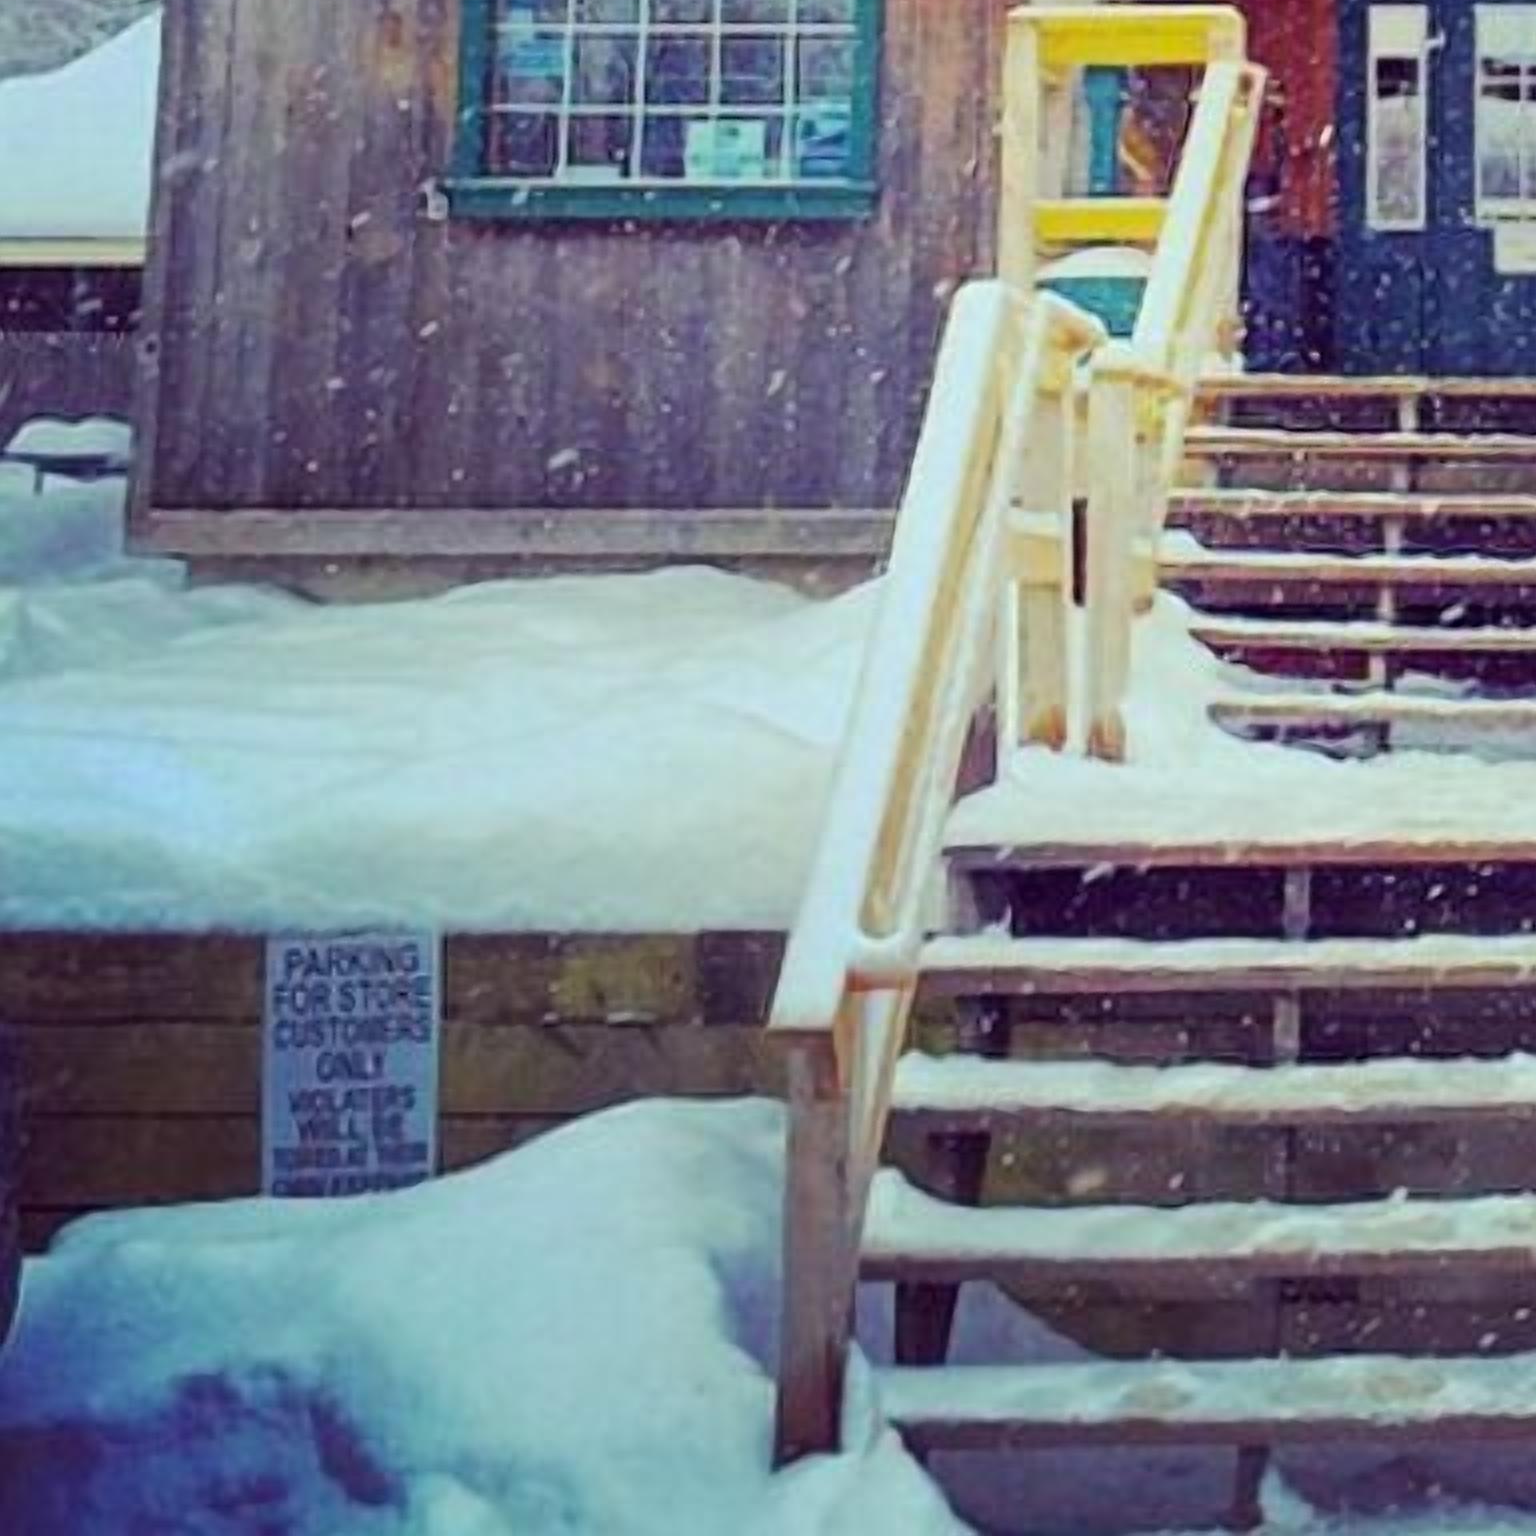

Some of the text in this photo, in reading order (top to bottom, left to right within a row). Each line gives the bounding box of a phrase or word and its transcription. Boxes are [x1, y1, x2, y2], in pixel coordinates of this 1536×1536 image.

[284, 943, 420, 977] PARKING
[272, 976, 433, 1013] FOR STORE
[273, 1015, 433, 1048] CUSTOMERS
[316, 1051, 385, 1083] ONLY
